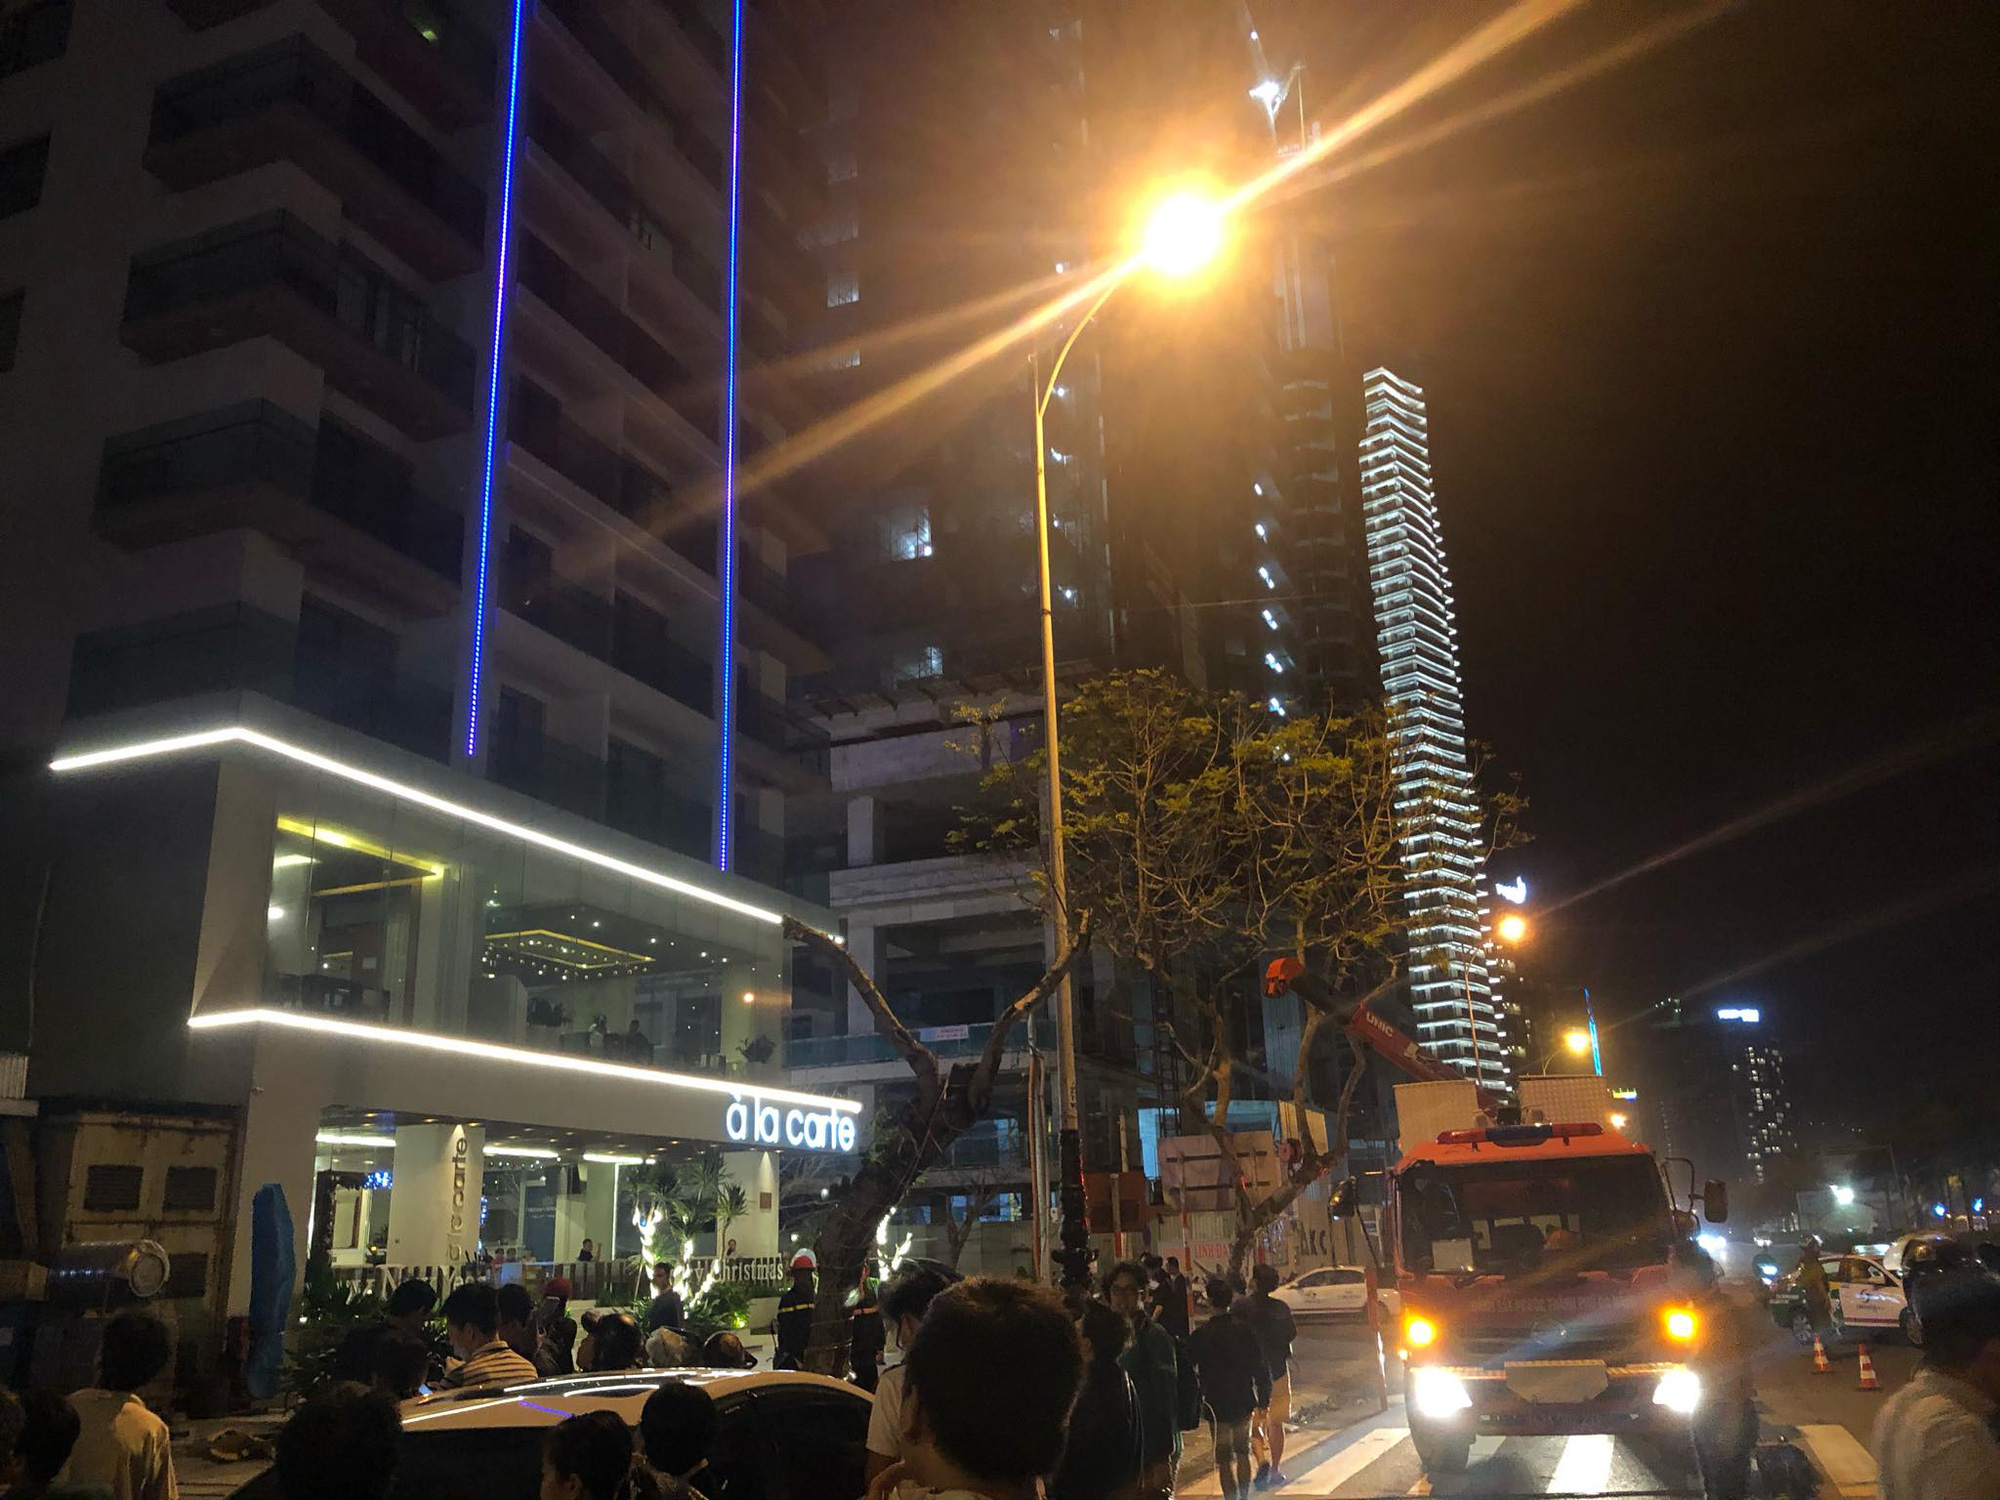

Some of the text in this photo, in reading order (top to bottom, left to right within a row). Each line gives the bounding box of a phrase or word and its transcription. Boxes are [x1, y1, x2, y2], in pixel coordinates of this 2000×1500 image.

[1366, 1011, 1393, 1037] UNIC
[725, 1092, 856, 1152] à la carte
[452, 1137, 468, 1208] carte
